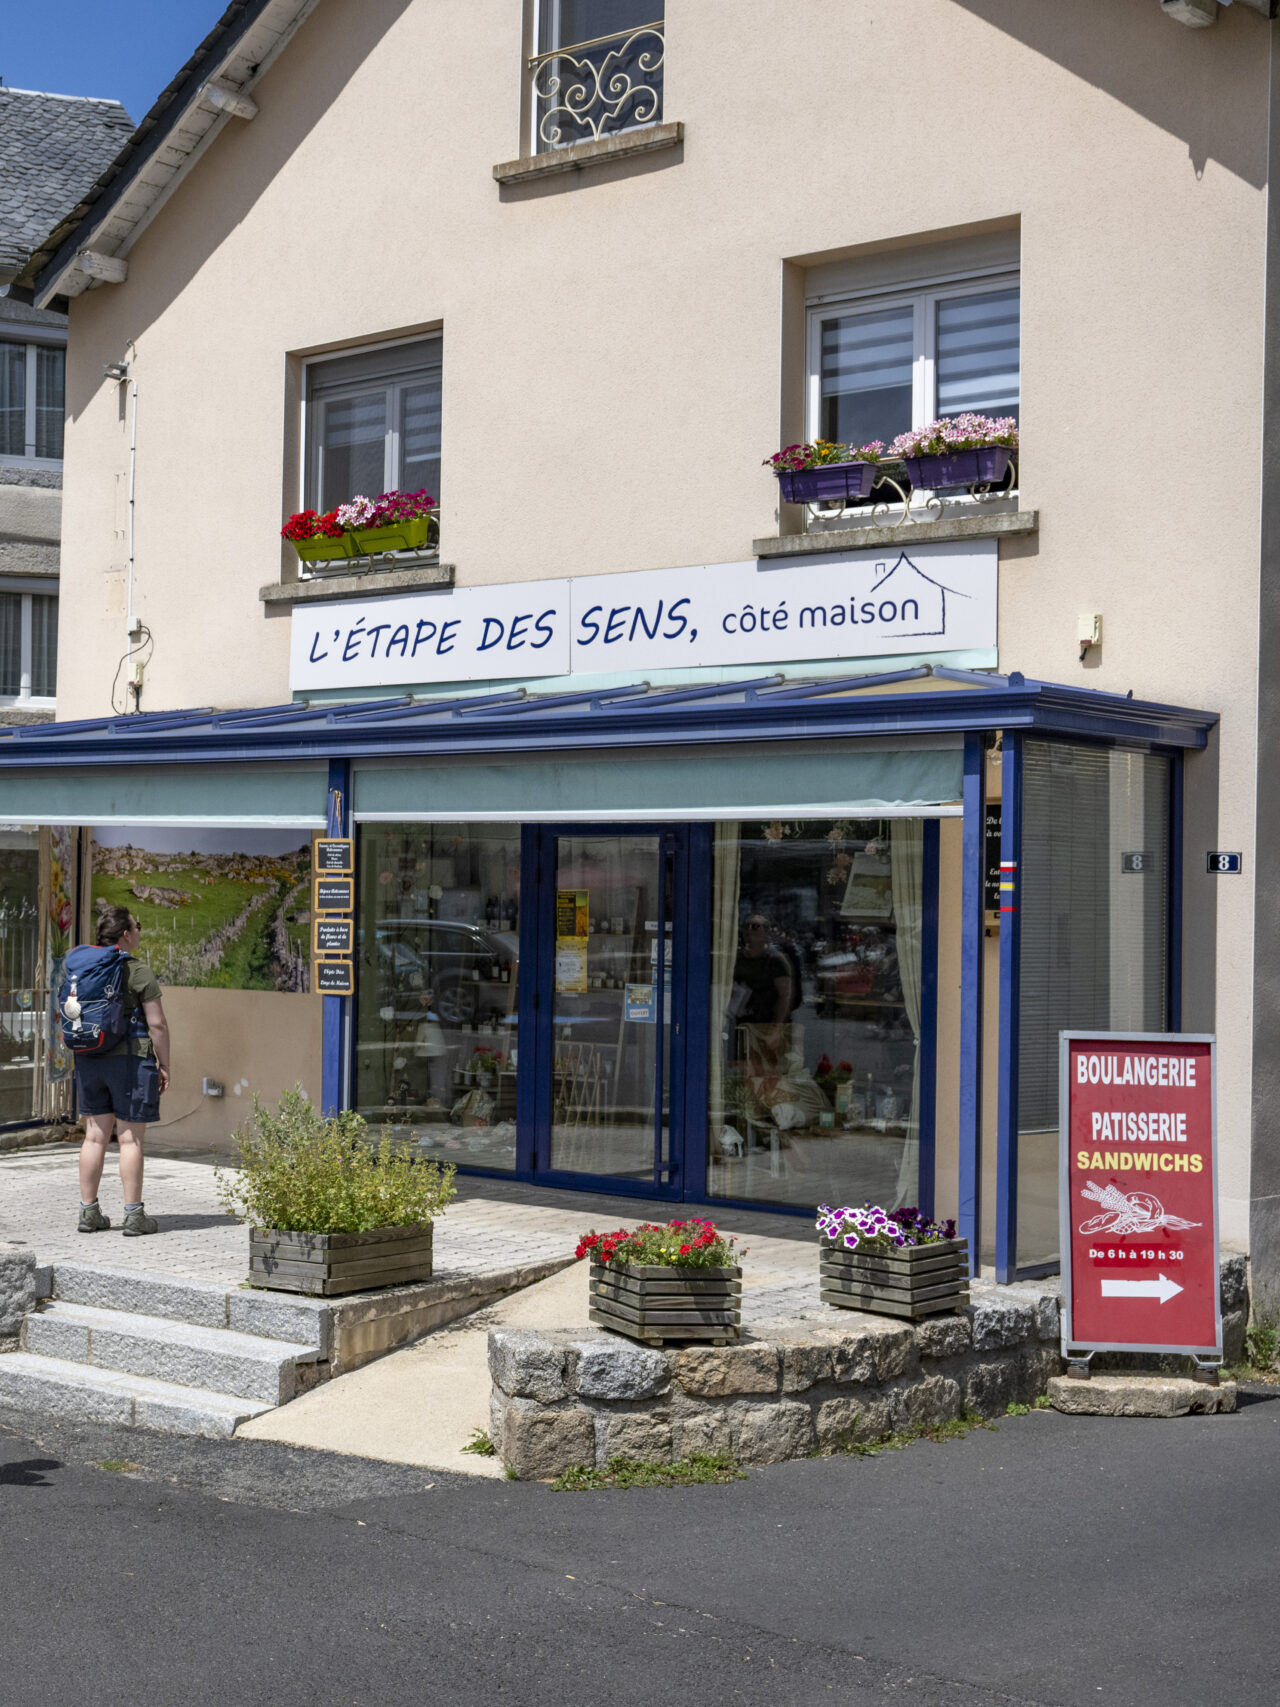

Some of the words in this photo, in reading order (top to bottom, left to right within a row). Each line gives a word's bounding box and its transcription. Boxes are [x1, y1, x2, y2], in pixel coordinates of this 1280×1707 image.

[309, 617, 462, 664] L'ÉTAPE
[476, 609, 557, 652] DES
[576, 598, 699, 647] SENS,
[722, 600, 789, 634] côté
[799, 596, 919, 628] maison
[1218, 855, 1230, 870] 8
[1077, 1055, 1196, 1087] BOULANGERIE
[1092, 1111, 1187, 1142] PATISSERIE
[1077, 1151, 1203, 1173] SANDWICHS
[1089, 1248, 1105, 1258] De
[1107, 1248, 1116, 1259] 6
[1118, 1249, 1126, 1259] h
[1129, 1249, 1137, 1259] à
[1140, 1250, 1155, 1259] 19
[1158, 1250, 1166, 1259] h
[1169, 1250, 1184, 1260] 30
